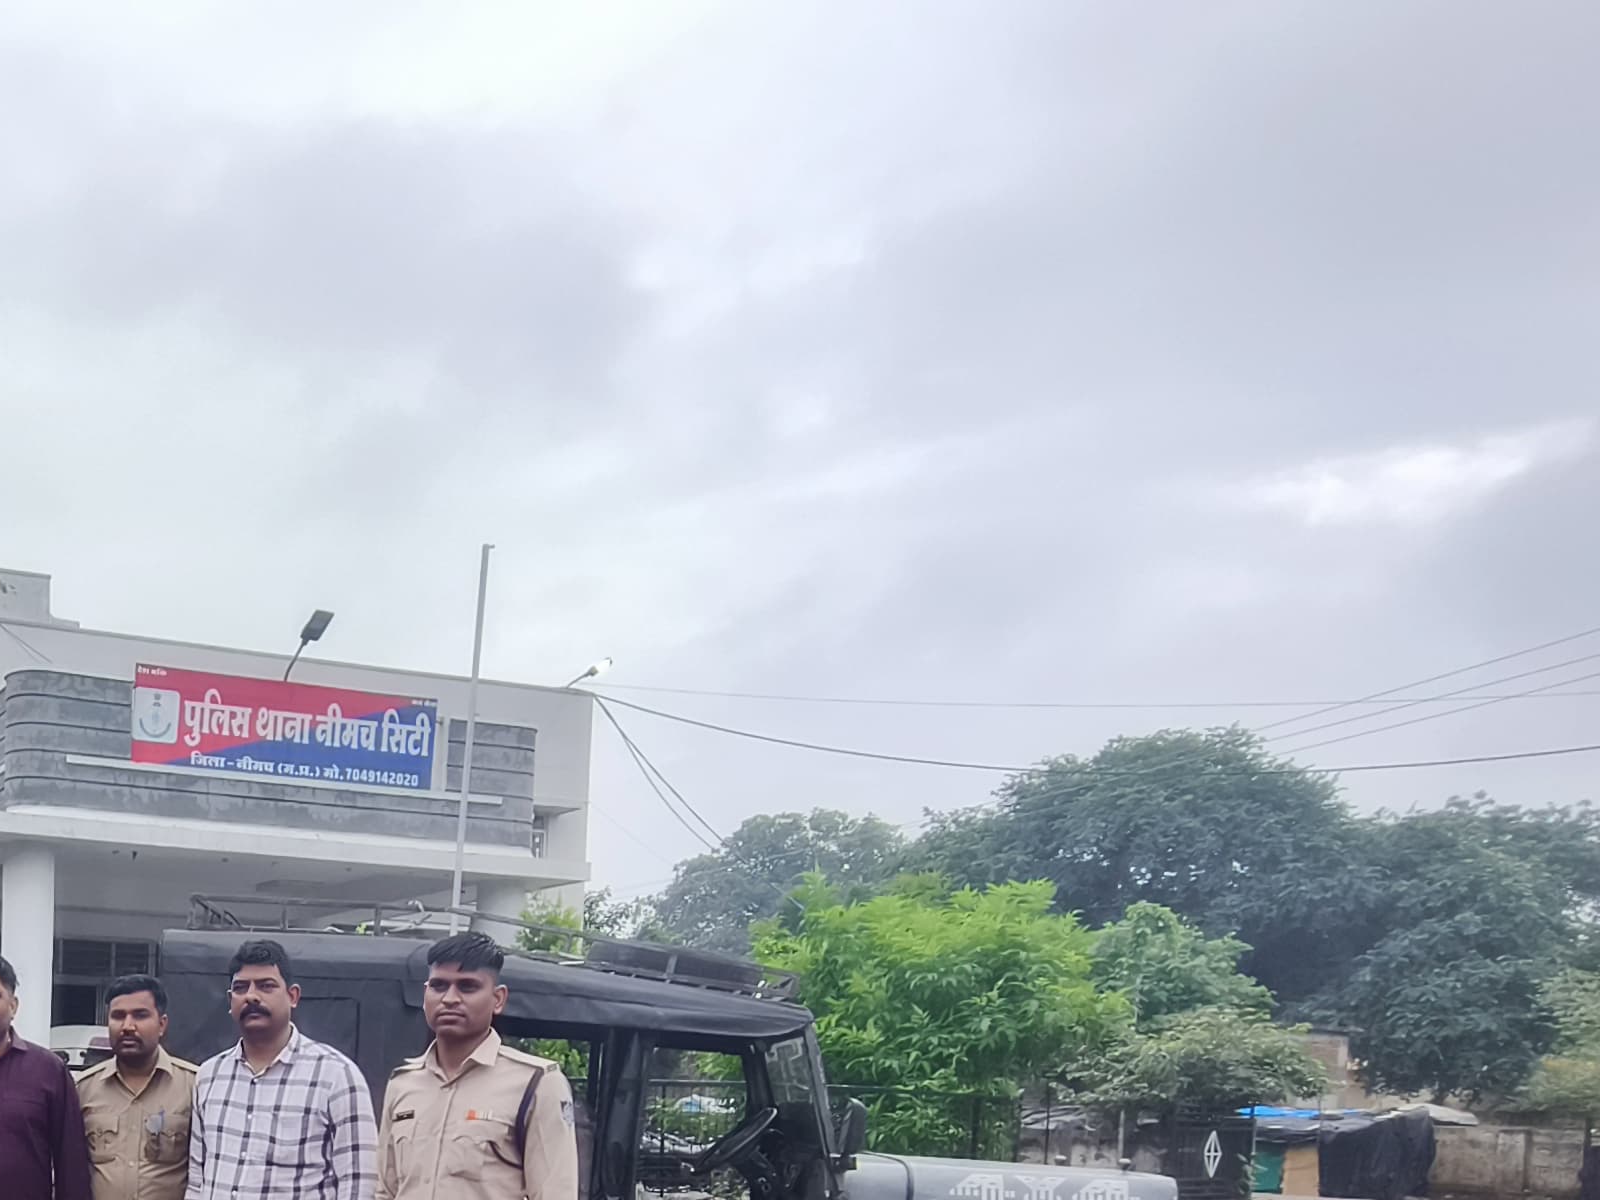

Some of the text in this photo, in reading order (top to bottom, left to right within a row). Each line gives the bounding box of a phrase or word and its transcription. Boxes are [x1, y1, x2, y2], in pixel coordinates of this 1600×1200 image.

[183, 688, 432, 757] पुलिस थाना नीमच सिटी
